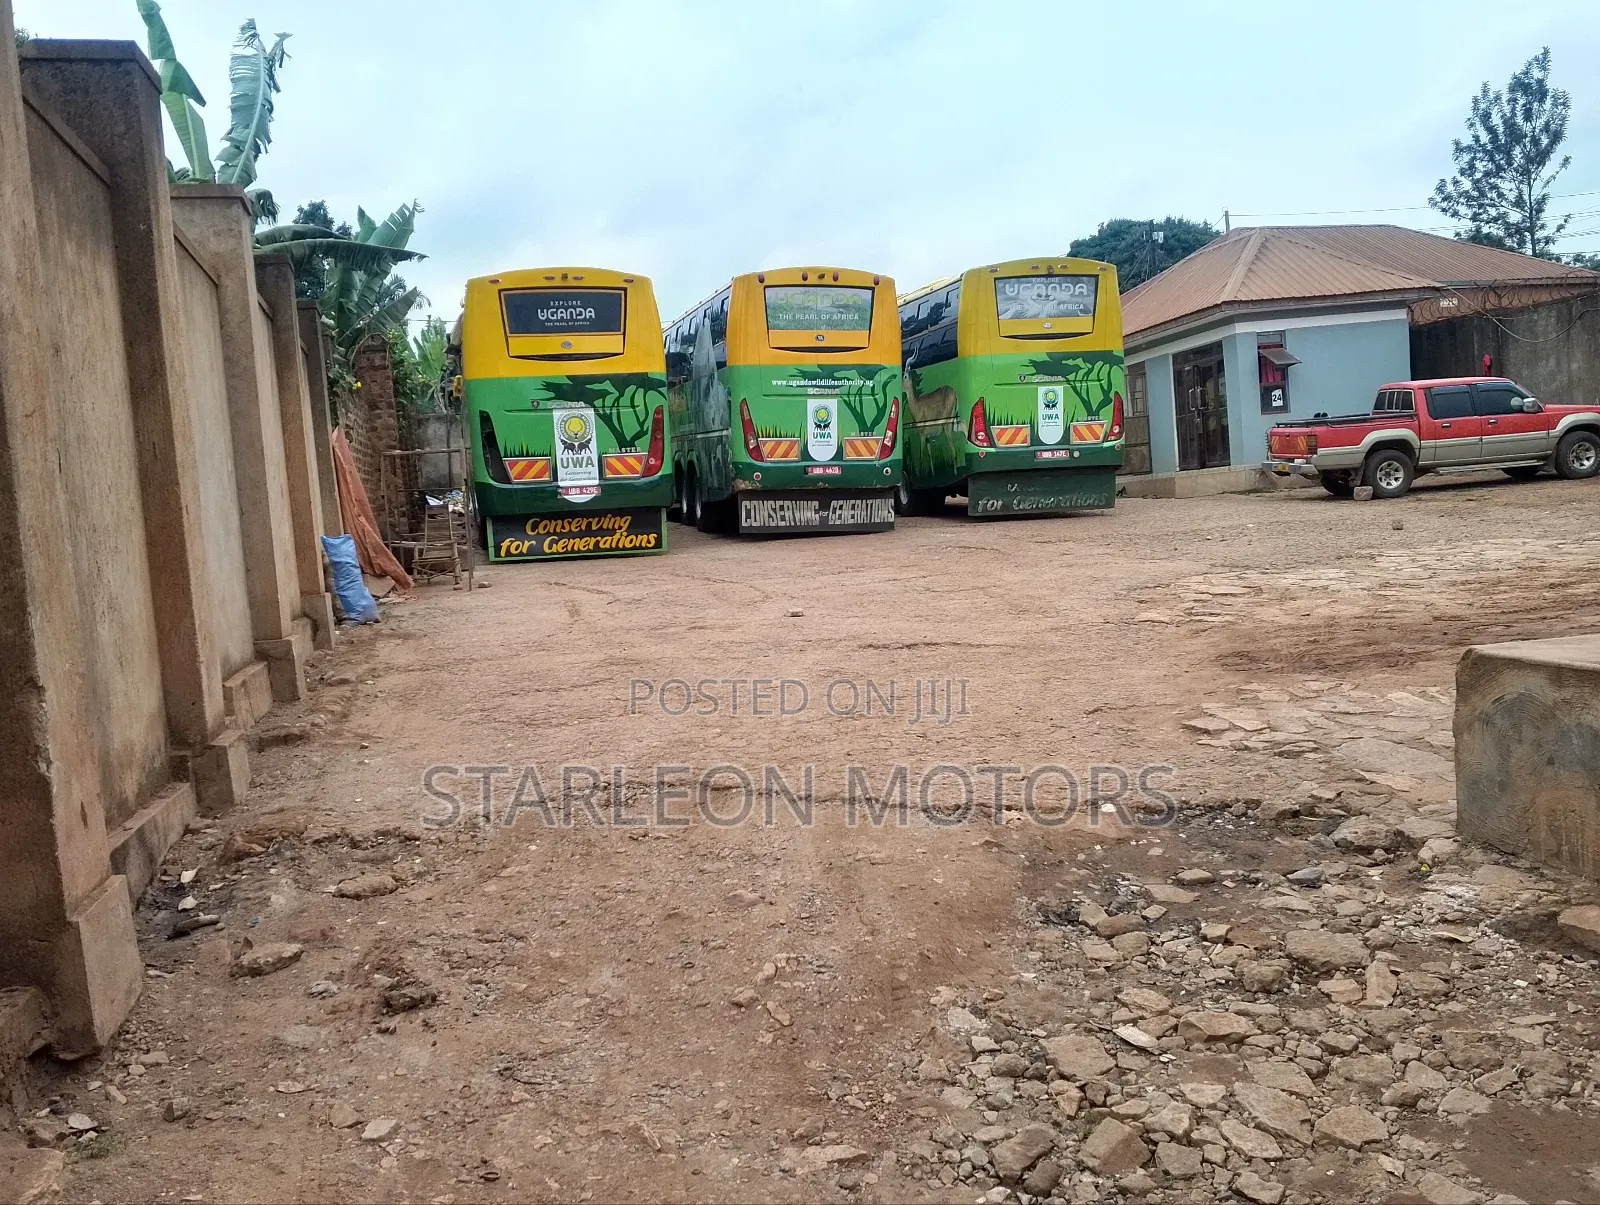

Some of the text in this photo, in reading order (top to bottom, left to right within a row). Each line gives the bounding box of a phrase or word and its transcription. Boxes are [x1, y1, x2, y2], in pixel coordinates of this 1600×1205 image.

[1005, 283, 1088, 296] UGANDA
[537, 307, 596, 320] UGANDA
[1272, 394, 1282, 402] 24
[812, 432, 832, 440] UWA
[560, 456, 595, 470] UWA
[582, 486, 598, 494] 429E
[741, 500, 820, 527] CONSERVING
[828, 498, 895, 524] GENERATIONS
[525, 514, 632, 536] Conserving
[500, 532, 658, 558] for Generations
